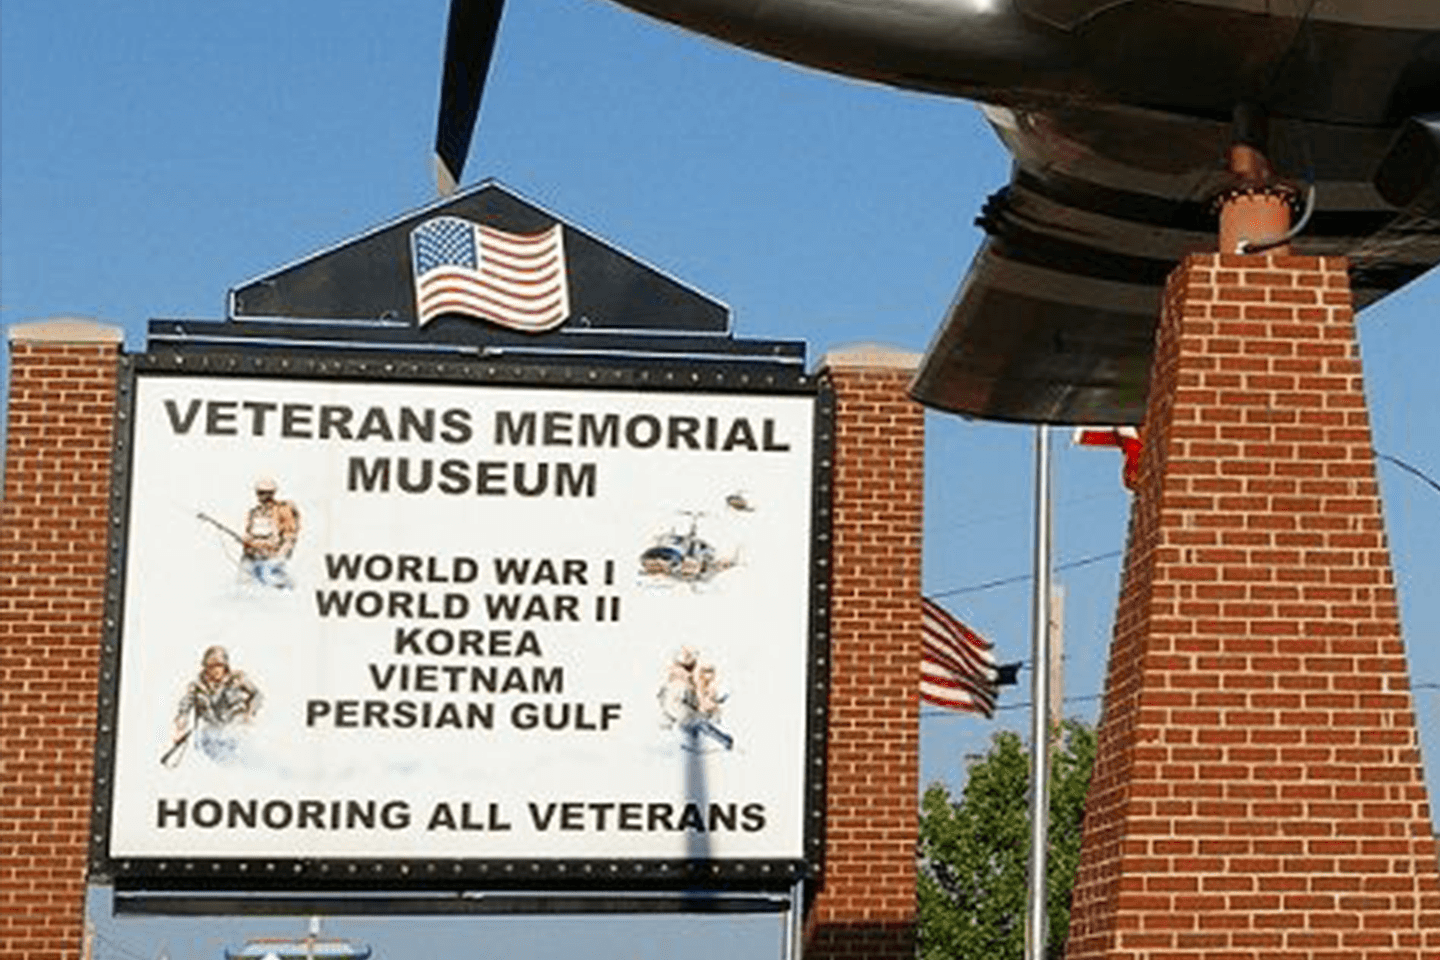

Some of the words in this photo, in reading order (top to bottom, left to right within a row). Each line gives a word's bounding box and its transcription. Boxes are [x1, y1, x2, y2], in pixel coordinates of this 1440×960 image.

[164, 399, 473, 444] VETERANS
[494, 411, 791, 452] MEMORIAL
[347, 457, 597, 498] MUSEUM
[325, 554, 479, 583] WORLD
[494, 558, 588, 586] WAR
[605, 560, 615, 586] I
[316, 590, 470, 619] WORLD
[485, 594, 580, 622] WAR
[594, 597, 620, 623] II
[394, 628, 542, 656] KOREA
[369, 664, 564, 694] VIETNAM
[306, 700, 494, 730] PERSIAN
[510, 702, 622, 731] GULF
[157, 799, 411, 831] HONORING
[426, 802, 512, 832] ALL
[528, 802, 766, 833] VETERANS
